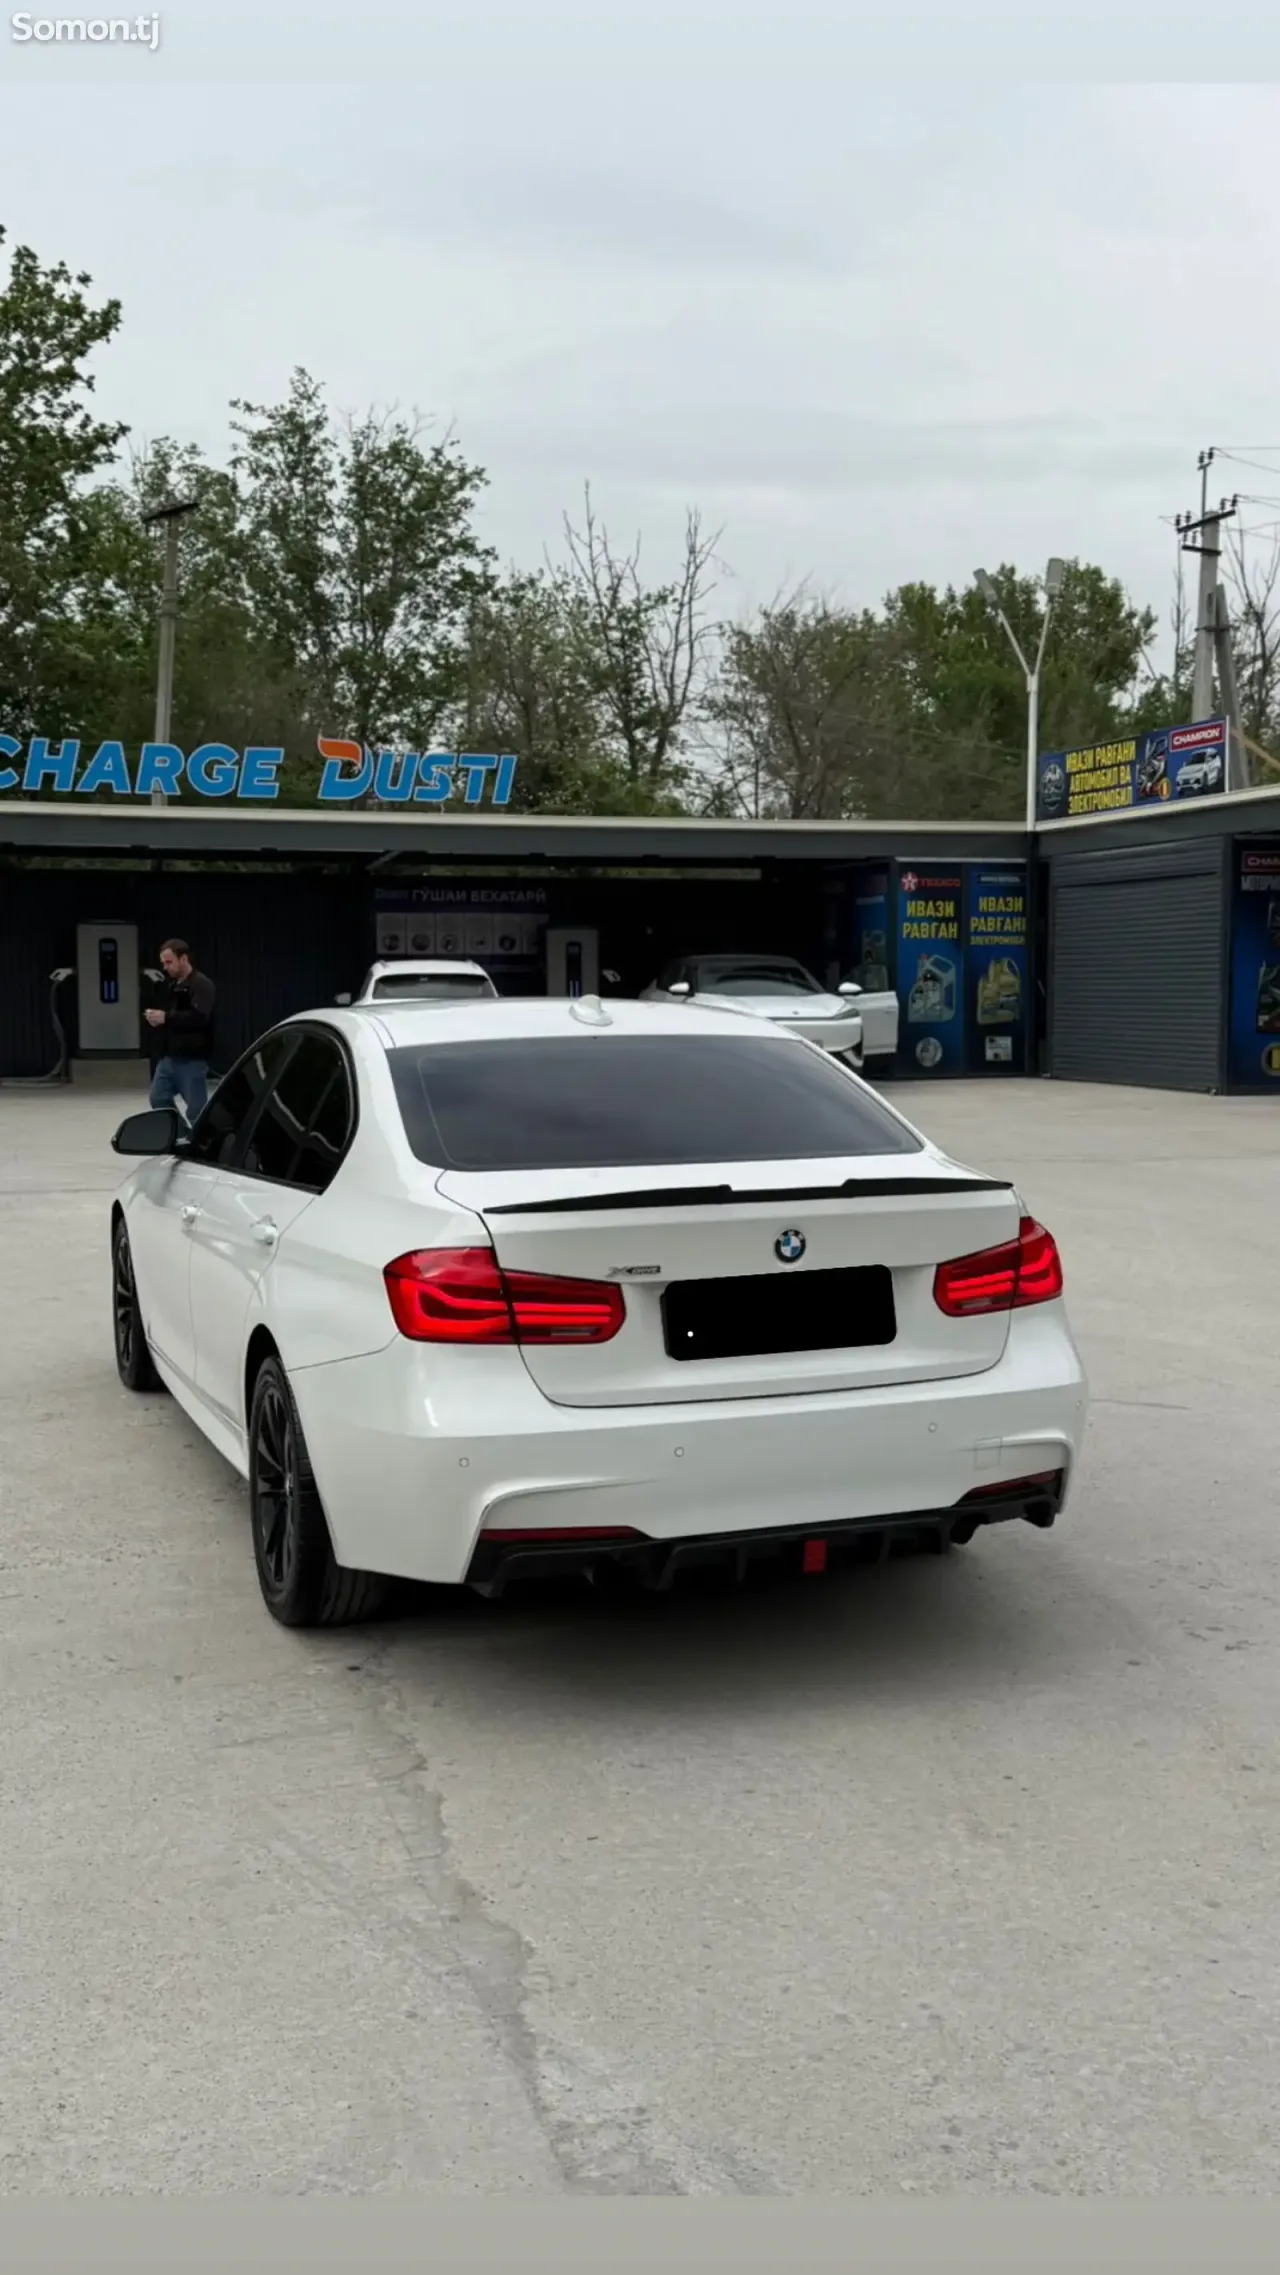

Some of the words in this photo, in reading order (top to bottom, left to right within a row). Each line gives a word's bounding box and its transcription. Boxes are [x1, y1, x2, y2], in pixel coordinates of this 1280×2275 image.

[1173, 727, 1220, 746] CHAMPION
[317, 731, 517, 805] DUSTI
[1120, 764, 1131, 785] ВА
[906, 899, 954, 918] ИВАЗИ
[978, 895, 1023, 912] ИВАЗИ
